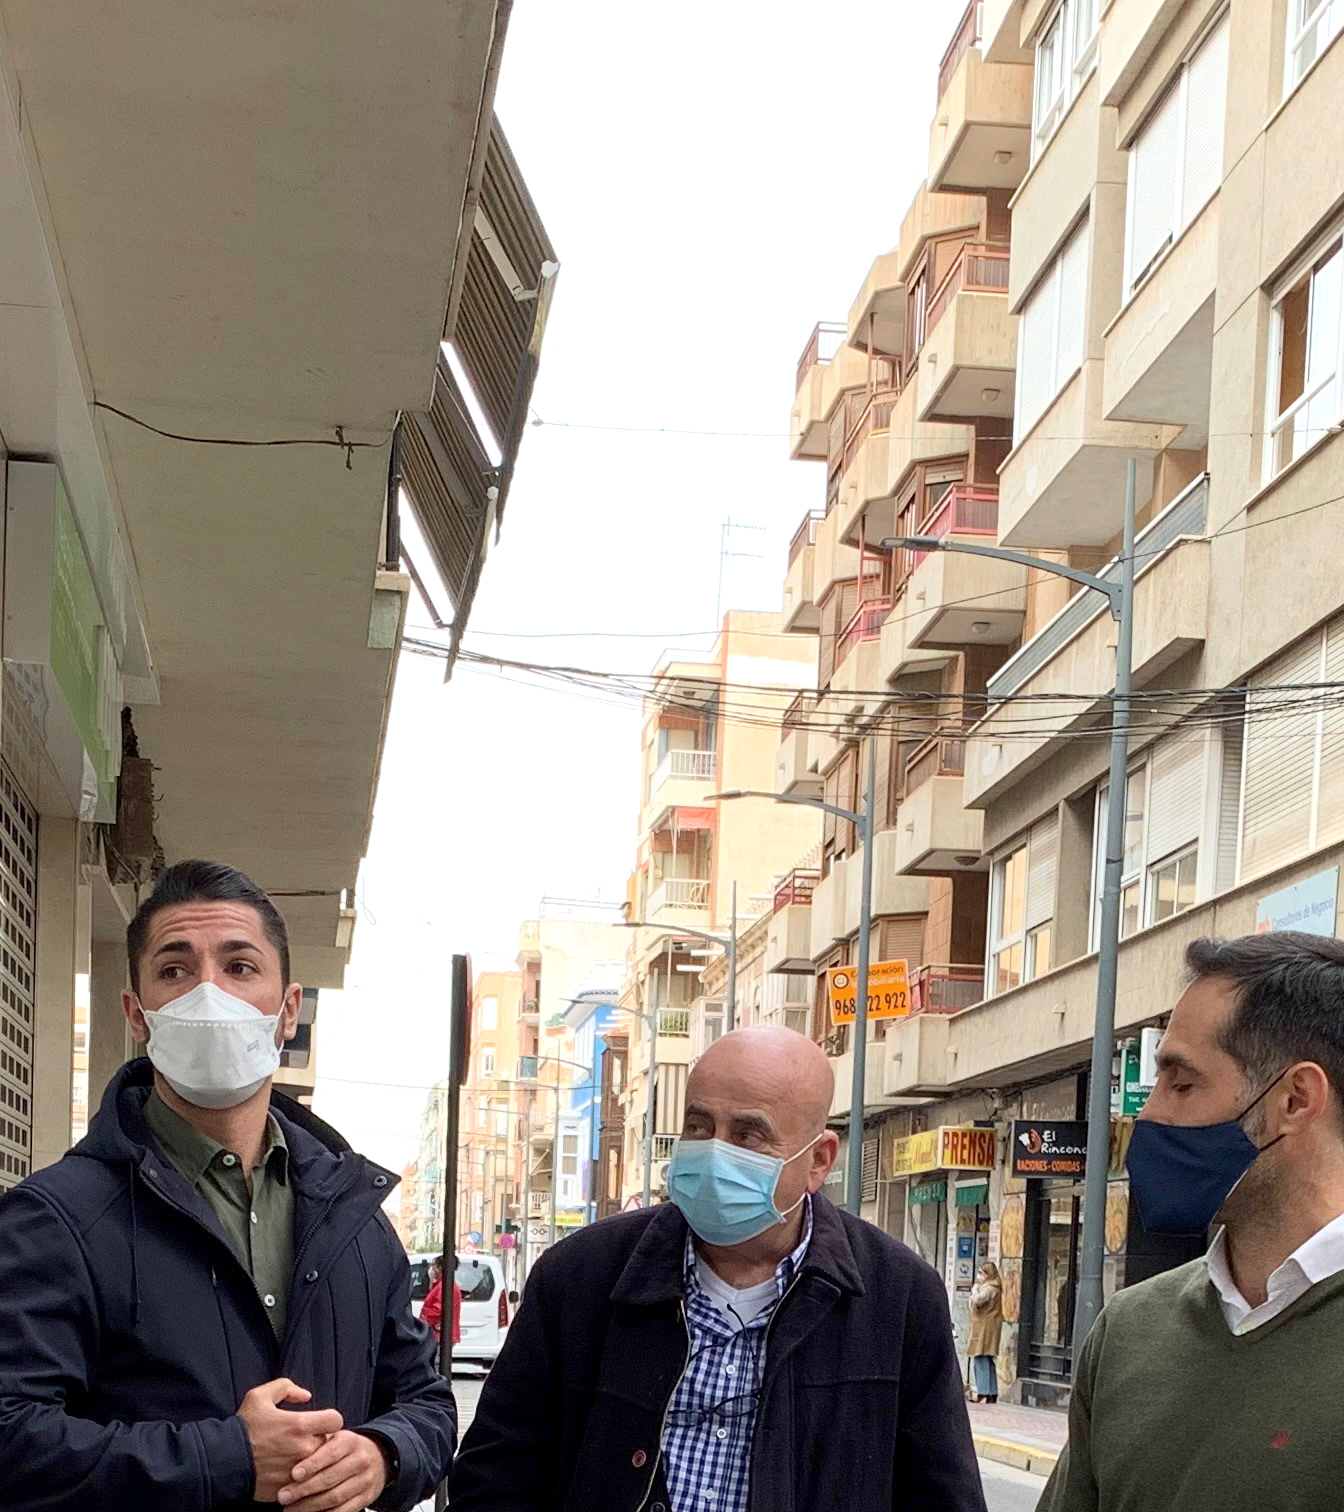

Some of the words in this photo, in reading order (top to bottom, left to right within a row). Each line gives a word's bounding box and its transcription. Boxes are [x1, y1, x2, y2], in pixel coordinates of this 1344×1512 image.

[835, 997, 856, 1016] 968
[864, 994, 881, 1012] 22
[885, 991, 906, 1010] 922
[943, 1131, 996, 1166] PRENSA
[1042, 1130, 1056, 1142] El
